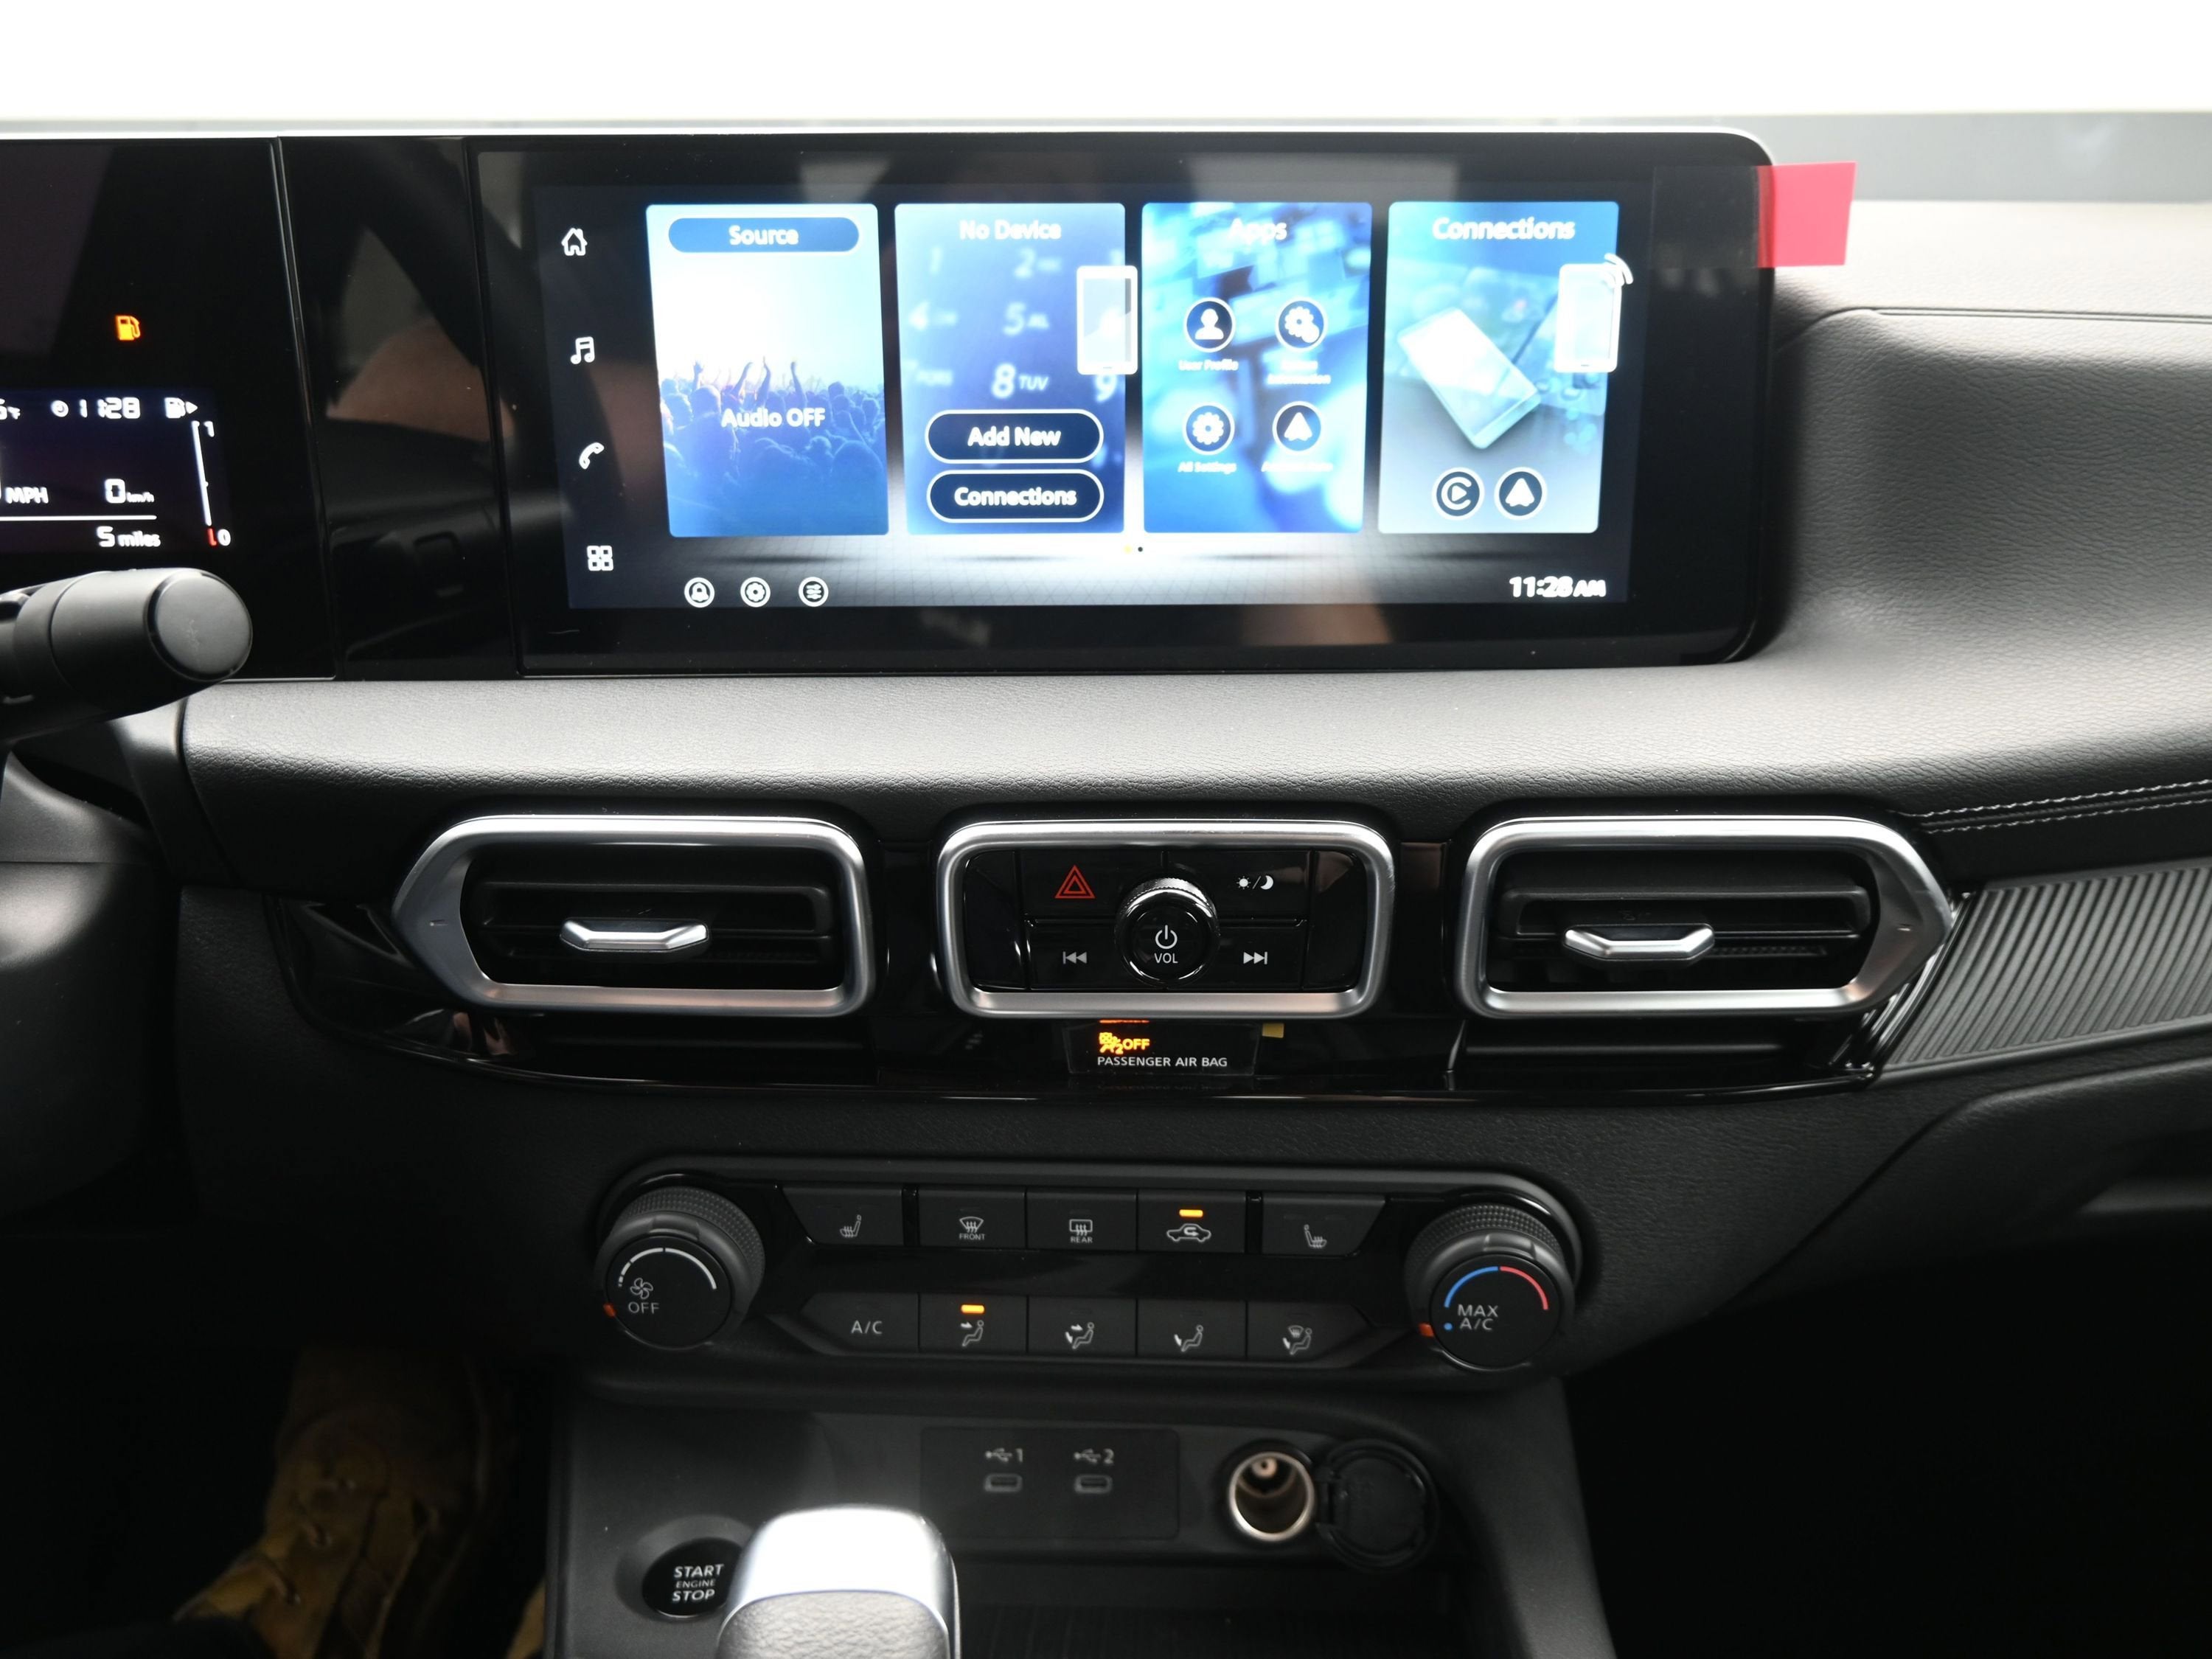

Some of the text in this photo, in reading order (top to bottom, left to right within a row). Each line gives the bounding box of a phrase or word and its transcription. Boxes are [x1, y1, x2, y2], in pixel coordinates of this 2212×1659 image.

[728, 225, 799, 246] Source
[959, 219, 1062, 240] No Device
[1230, 218, 1287, 246] Apps
[1432, 217, 1576, 240] Connections
[992, 363, 1049, 399] 8 TUV
[721, 408, 825, 428] Audio OFF
[204, 421, 215, 437] 1
[967, 425, 1062, 446] Add New
[4, 487, 49, 504] MPH
[104, 479, 126, 504] 0
[954, 487, 1077, 506] Connections
[97, 526, 161, 547] 5 miles
[1509, 576, 1607, 597] 11:28 AM
[1154, 953, 1178, 964] VOL
[1122, 1038, 1150, 1051] OFF
[1097, 1057, 1228, 1067] PASSENGER AIR BAG
[959, 1233, 985, 1241] FRONT
[1070, 1236, 1093, 1244] REAR
[628, 1302, 659, 1314] OFF
[1458, 1304, 1498, 1317] MAX
[851, 1321, 883, 1335] A/C
[1459, 1318, 1493, 1331] A/C
[1015, 1447, 1023, 1463] 1
[1104, 1448, 1115, 1464] 2
[674, 1564, 724, 1578] START
[675, 1579, 716, 1588] ENGINE
[672, 1589, 715, 1602] STOP
